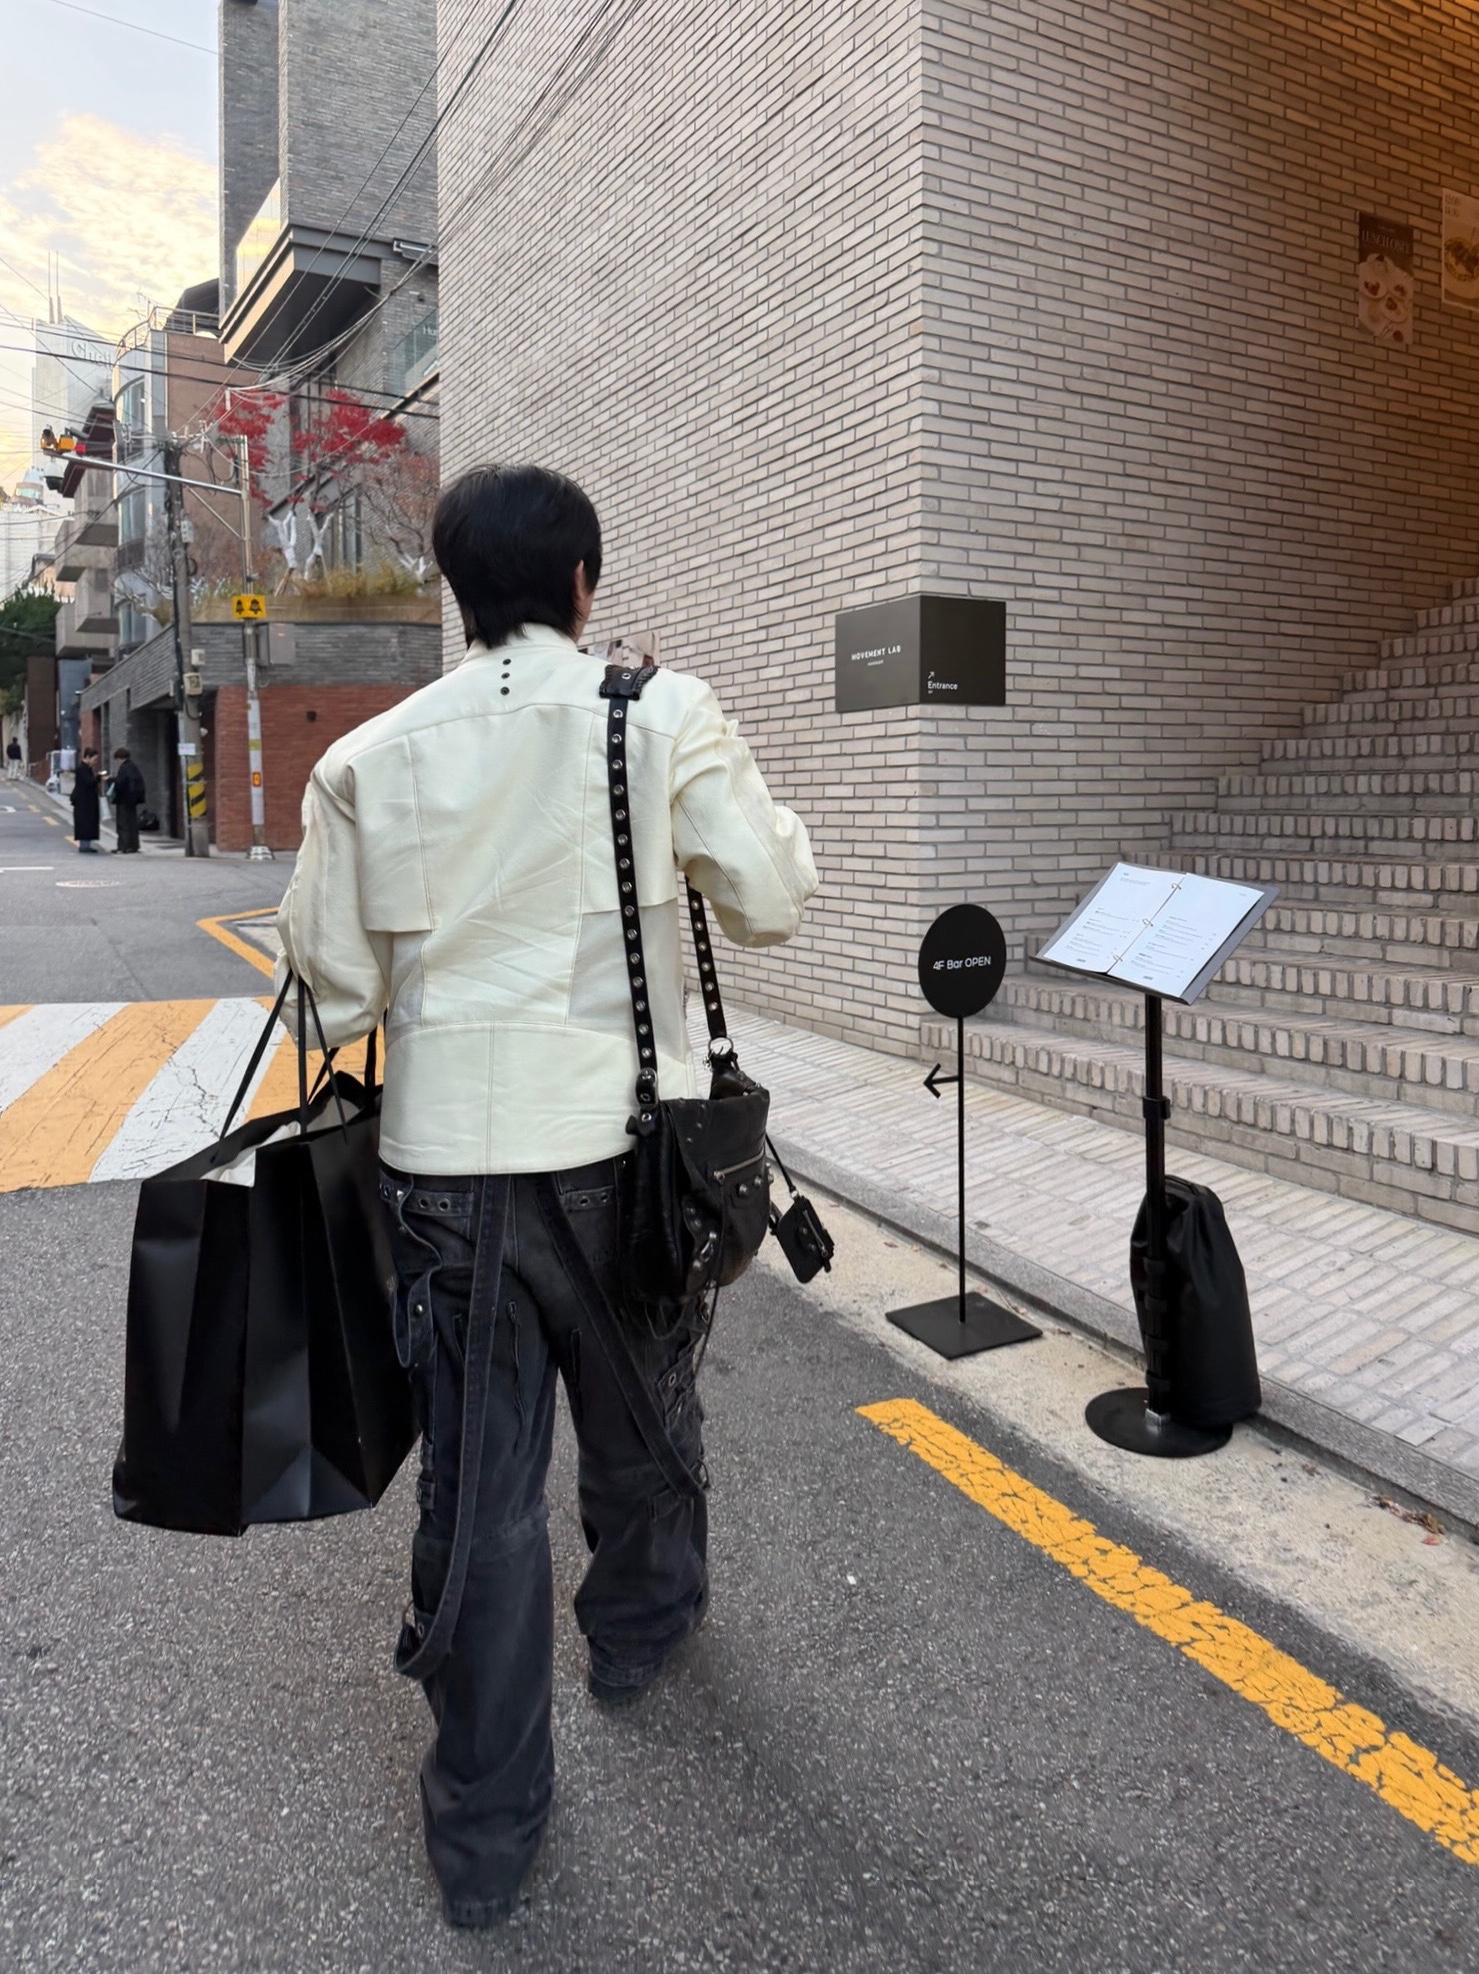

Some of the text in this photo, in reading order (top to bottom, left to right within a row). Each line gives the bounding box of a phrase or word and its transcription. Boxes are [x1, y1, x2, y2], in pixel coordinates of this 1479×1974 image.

[851, 645, 901, 661] MOVEMENT LAB
[927, 680, 958, 690] Entrance
[932, 955, 991, 970] 4F Bar OPEN
